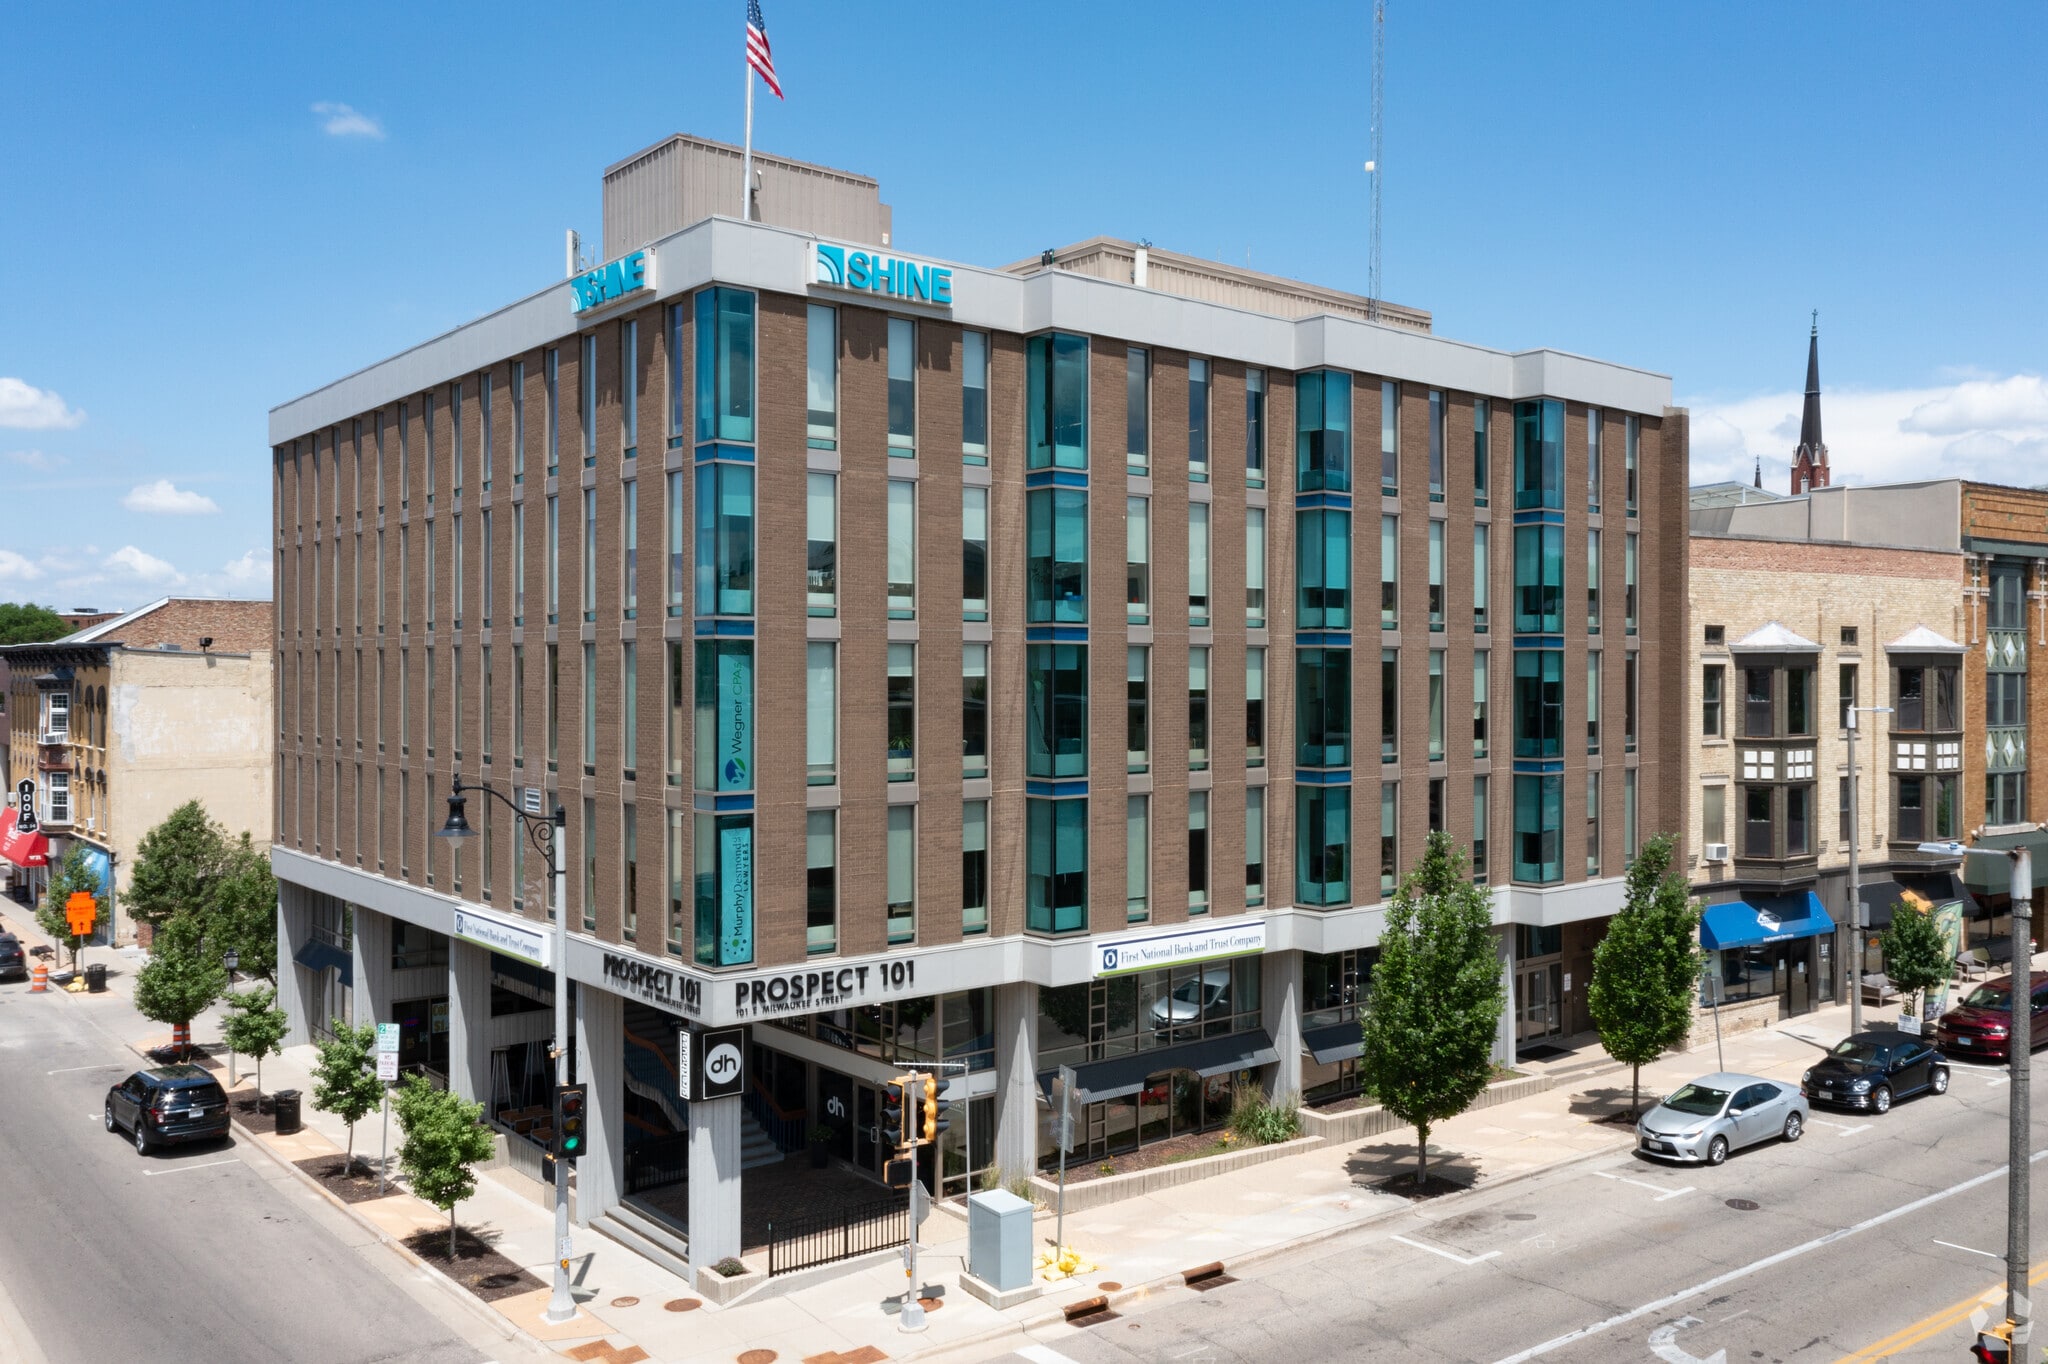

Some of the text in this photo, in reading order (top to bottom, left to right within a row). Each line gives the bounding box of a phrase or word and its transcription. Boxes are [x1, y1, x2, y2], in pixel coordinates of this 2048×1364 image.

[587, 250, 645, 306] SHINE
[847, 252, 952, 303] SHINE
[732, 662, 745, 754] Wegner CPAs
[23, 784, 31, 821] IOOF
[1121, 935, 1261, 964] First National Bank and Trust Company
[604, 953, 701, 1005] PROSPECT 101
[735, 960, 915, 1006] PROSPECT 101
[736, 994, 844, 1018] 101 E MILWAUKEE STREET
[711, 1054, 736, 1074] dh
[827, 1096, 845, 1118] dh
